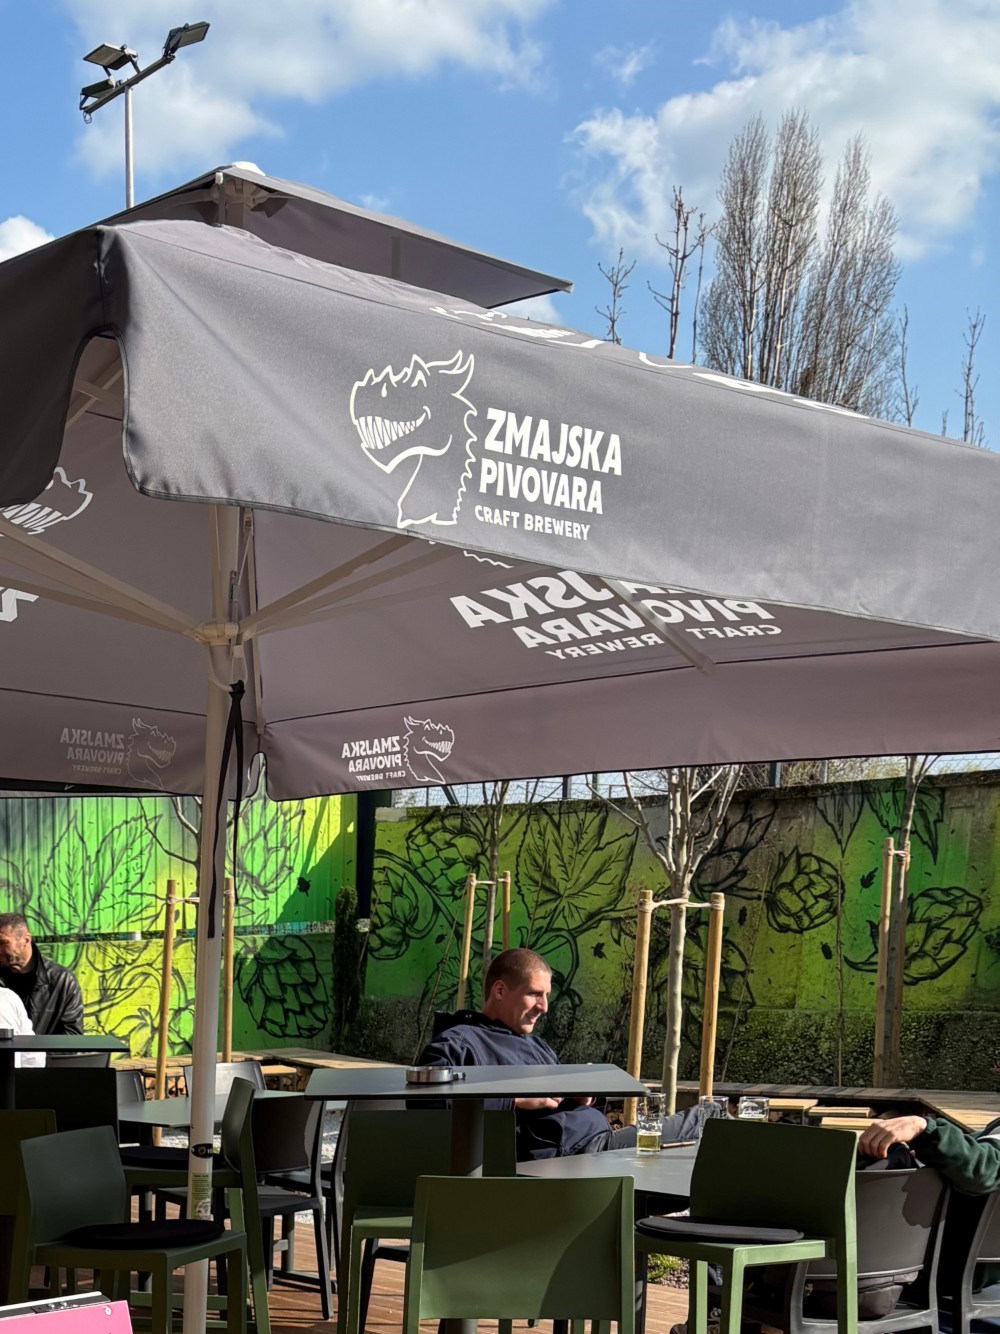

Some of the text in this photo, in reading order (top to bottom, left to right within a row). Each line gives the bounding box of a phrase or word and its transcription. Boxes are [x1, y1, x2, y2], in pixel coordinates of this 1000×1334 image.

[484, 407, 622, 476] ZMAJSKA
[479, 458, 603, 514] PIVOVARA
[474, 505, 590, 541] CRAFT BREWERY
